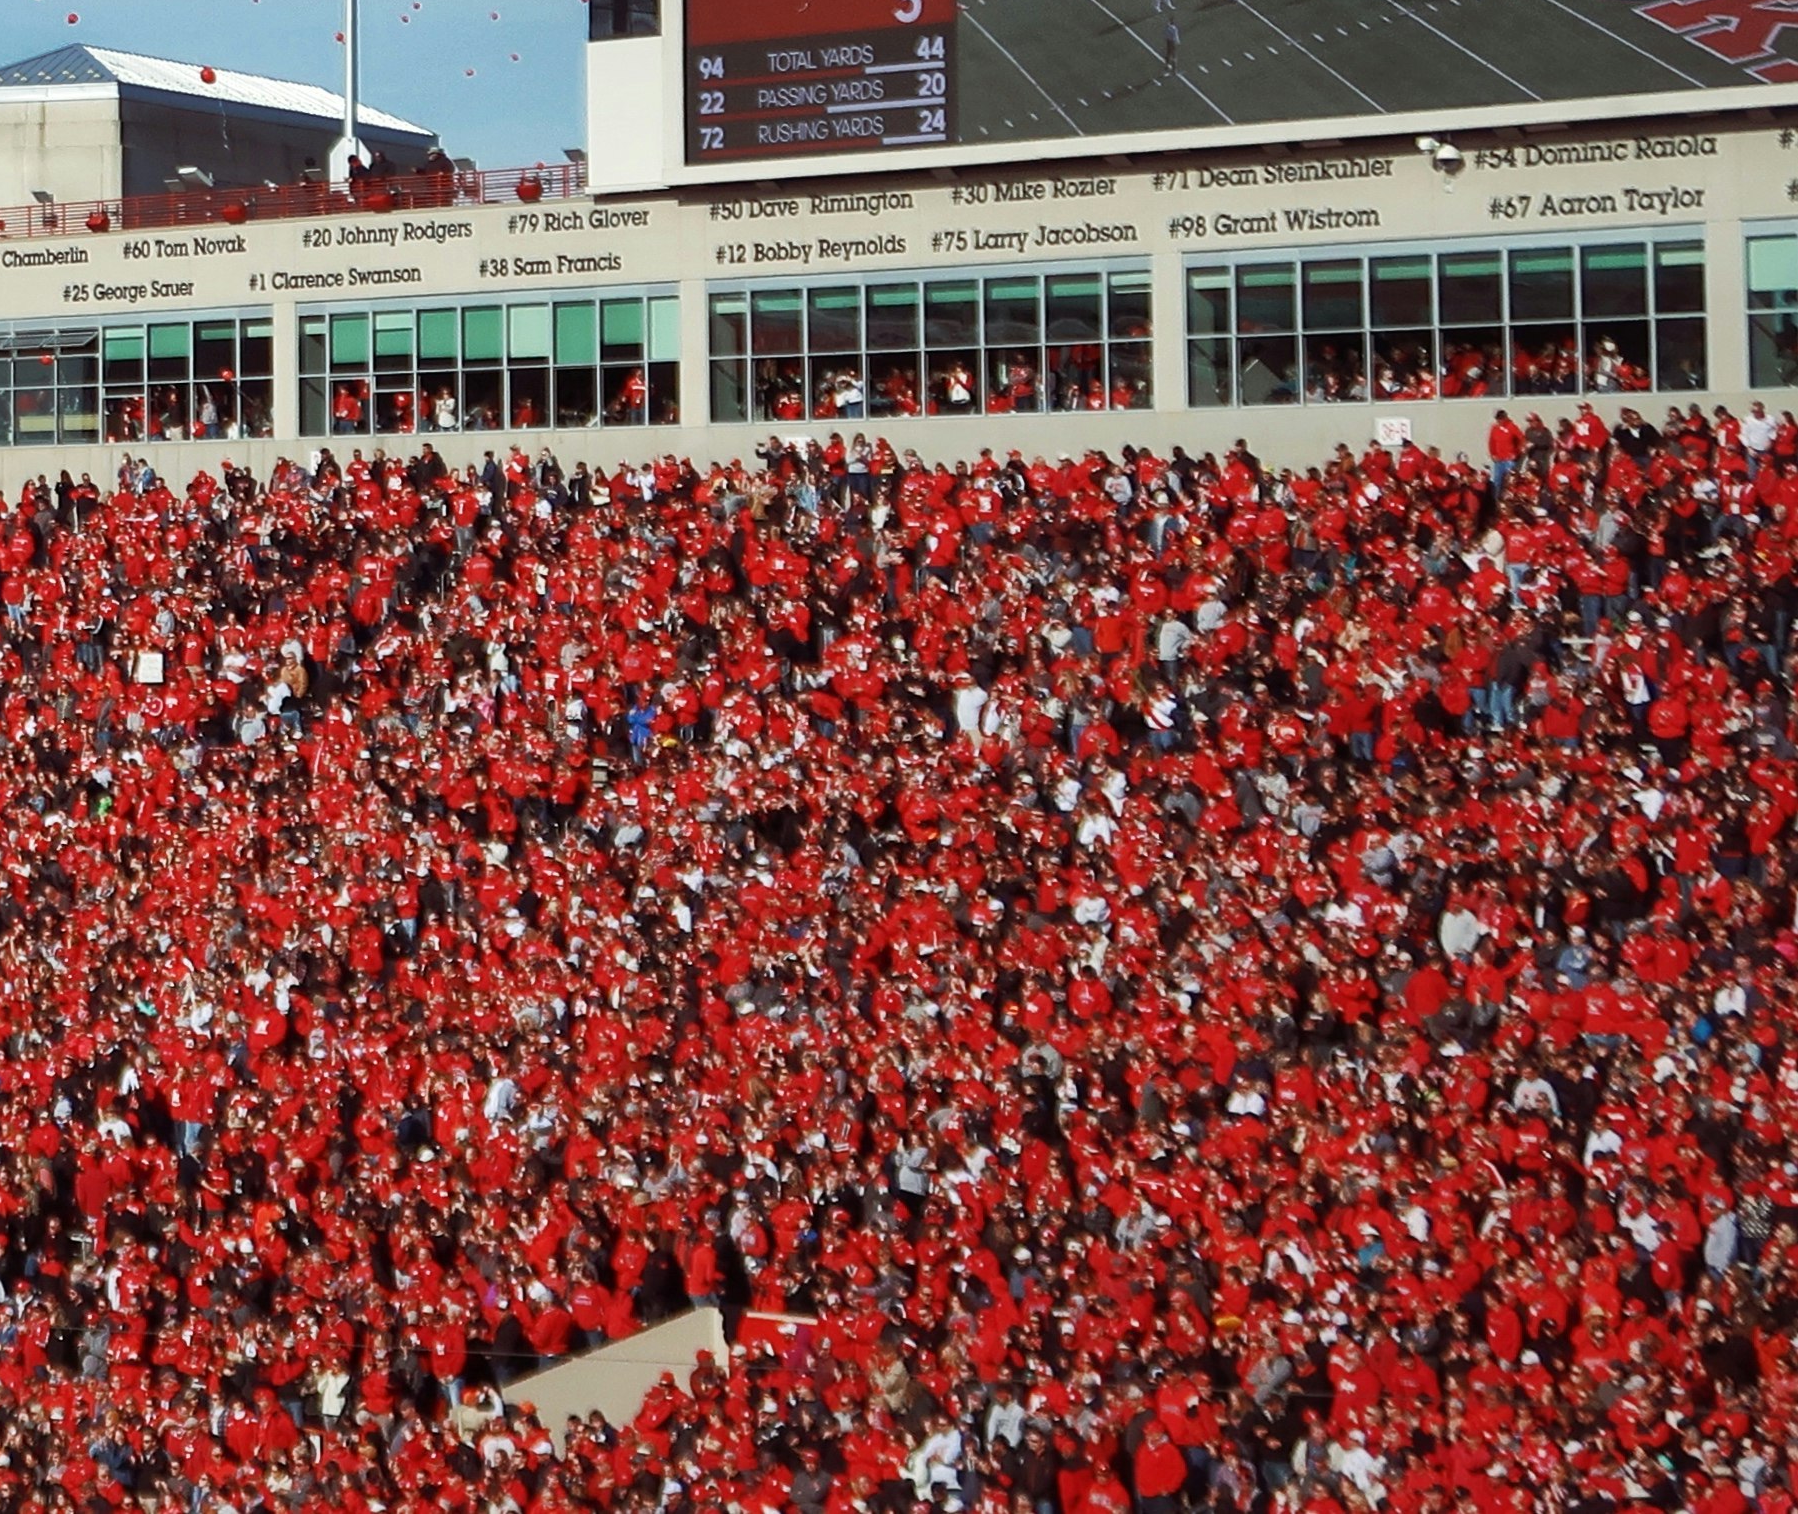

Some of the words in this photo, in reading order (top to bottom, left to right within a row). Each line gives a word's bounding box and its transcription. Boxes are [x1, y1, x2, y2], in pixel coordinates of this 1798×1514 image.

[699, 56, 725, 80] 94
[767, 52, 817, 73] TOTAL
[820, 45, 874, 68] YARDS
[916, 36, 945, 60] 44
[699, 92, 725, 115] 22
[758, 85, 827, 108] PASSING
[831, 79, 884, 101] YARDS
[918, 73, 946, 96] 20
[699, 127, 725, 150] 72
[758, 120, 828, 143] RUSHING
[832, 116, 884, 137] YARDS
[919, 109, 946, 132] 24
[1474, 147, 1517, 171] #54
[1522, 140, 1629, 167] Dominic
[1634, 135, 1718, 161] Raiola
[1152, 169, 1189, 192] #71
[1197, 166, 1259, 189] Dean
[1264, 156, 1395, 185] Steinkuhler
[709, 198, 743, 222] #50
[748, 197, 799, 220] Dave
[809, 191, 914, 218] Rimington
[951, 185, 988, 206] #30
[993, 178, 1046, 203] Mike
[1051, 176, 1118, 199] Rozier
[1487, 195, 1532, 220] #67
[1538, 193, 1618, 218] Aaron
[1622, 186, 1705, 216] Taylor
[303, 228, 333, 249] #20
[335, 222, 399, 247] Johnny
[402, 220, 473, 244] Rodgers
[508, 214, 540, 235] #79
[544, 210, 585, 233] Rich
[587, 207, 651, 230] Glover
[1168, 215, 1206, 239] #98
[1214, 211, 1278, 235] Grant
[1283, 205, 1381, 232] Wistrom
[122, 241, 150, 260] #60
[154, 239, 188, 258] Tom
[193, 235, 247, 256] Novak
[716, 244, 747, 265] #12
[752, 239, 814, 265] Bobby
[818, 234, 907, 262] Reynolds
[931, 231, 968, 253] #75
[973, 228, 1029, 254] Larry
[1034, 222, 1138, 247] Jacobson
[2, 246, 89, 269] Chamberlin
[478, 258, 509, 279] #38
[513, 256, 552, 277] Sam
[556, 252, 623, 274] Francis
[63, 284, 90, 303] #25
[92, 282, 147, 304] George
[151, 279, 195, 298] Sauer
[249, 271, 268, 292] #1
[271, 268, 345, 291] Clarence
[348, 265, 422, 286] Swanson
